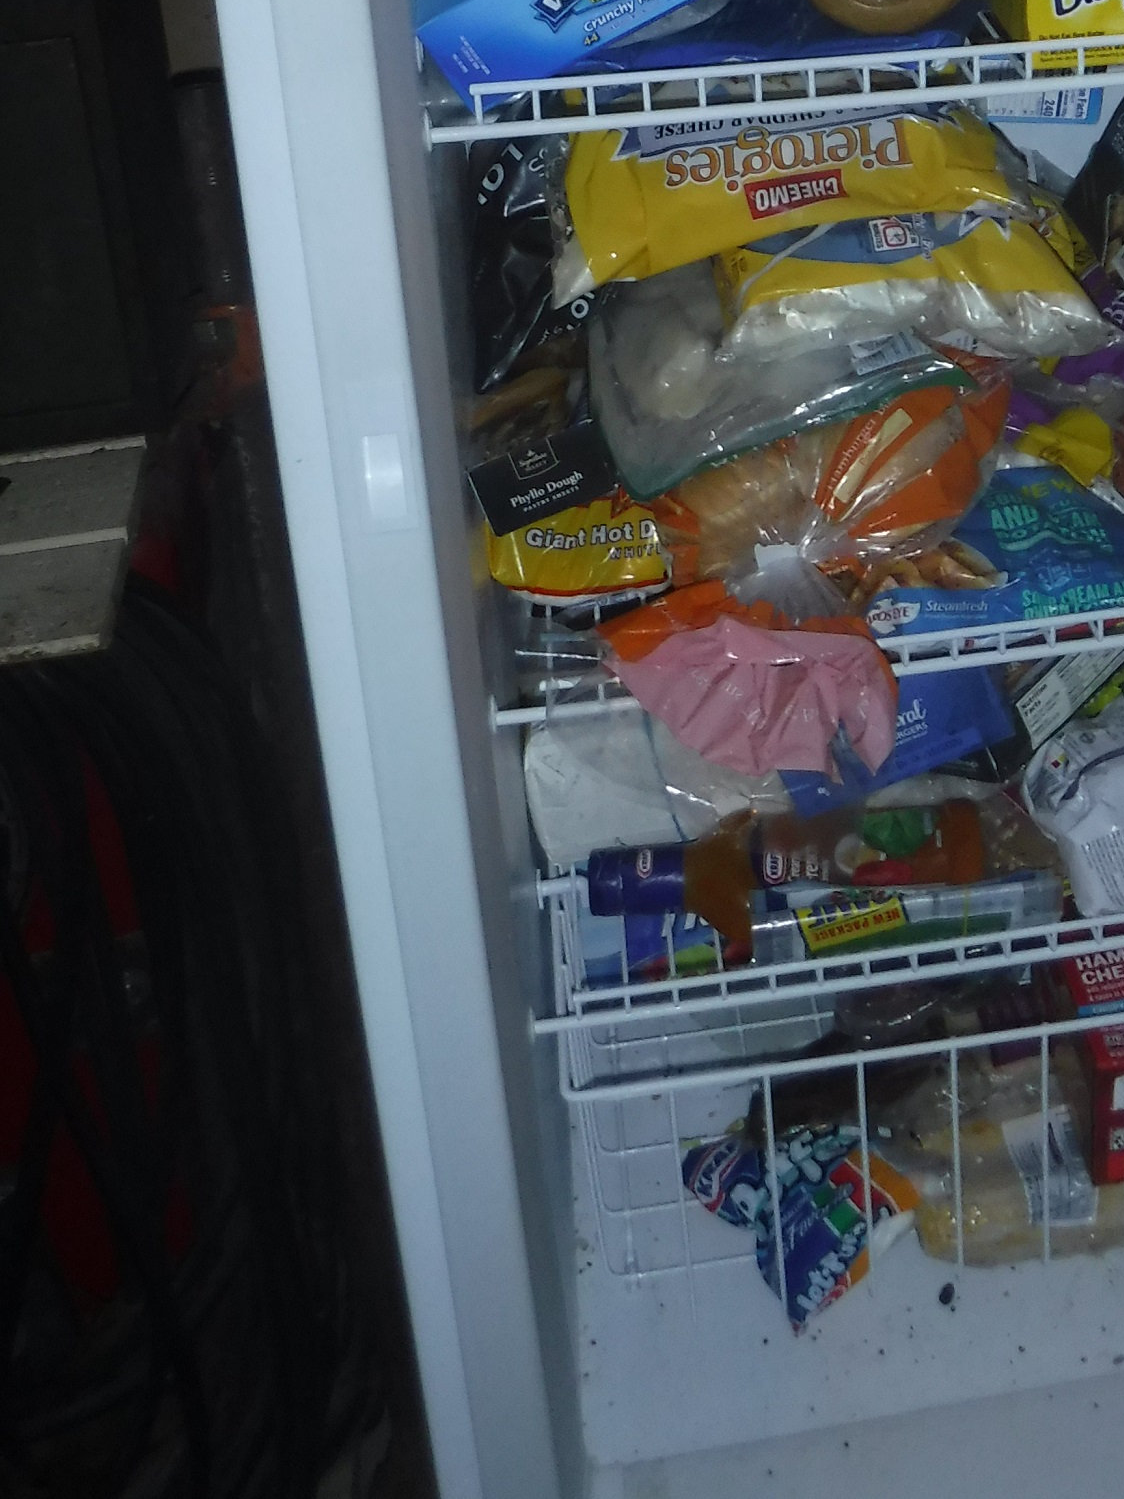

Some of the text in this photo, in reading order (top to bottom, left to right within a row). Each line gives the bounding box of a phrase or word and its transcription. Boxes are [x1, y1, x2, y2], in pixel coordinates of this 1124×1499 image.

[583, 0, 635, 33] Crunchy
[1041, 99, 1054, 117] 240
[654, 120, 724, 140] CHEESE
[666, 117, 913, 192] Pierogies
[755, 177, 840, 212] CHEEMO
[510, 470, 584, 509] Phyllo Dough
[990, 504, 1039, 531] AND
[525, 521, 634, 551] Giant Hot
[925, 598, 988, 614] Steamfresh
[814, 910, 900, 941] NEW PACKAGE
